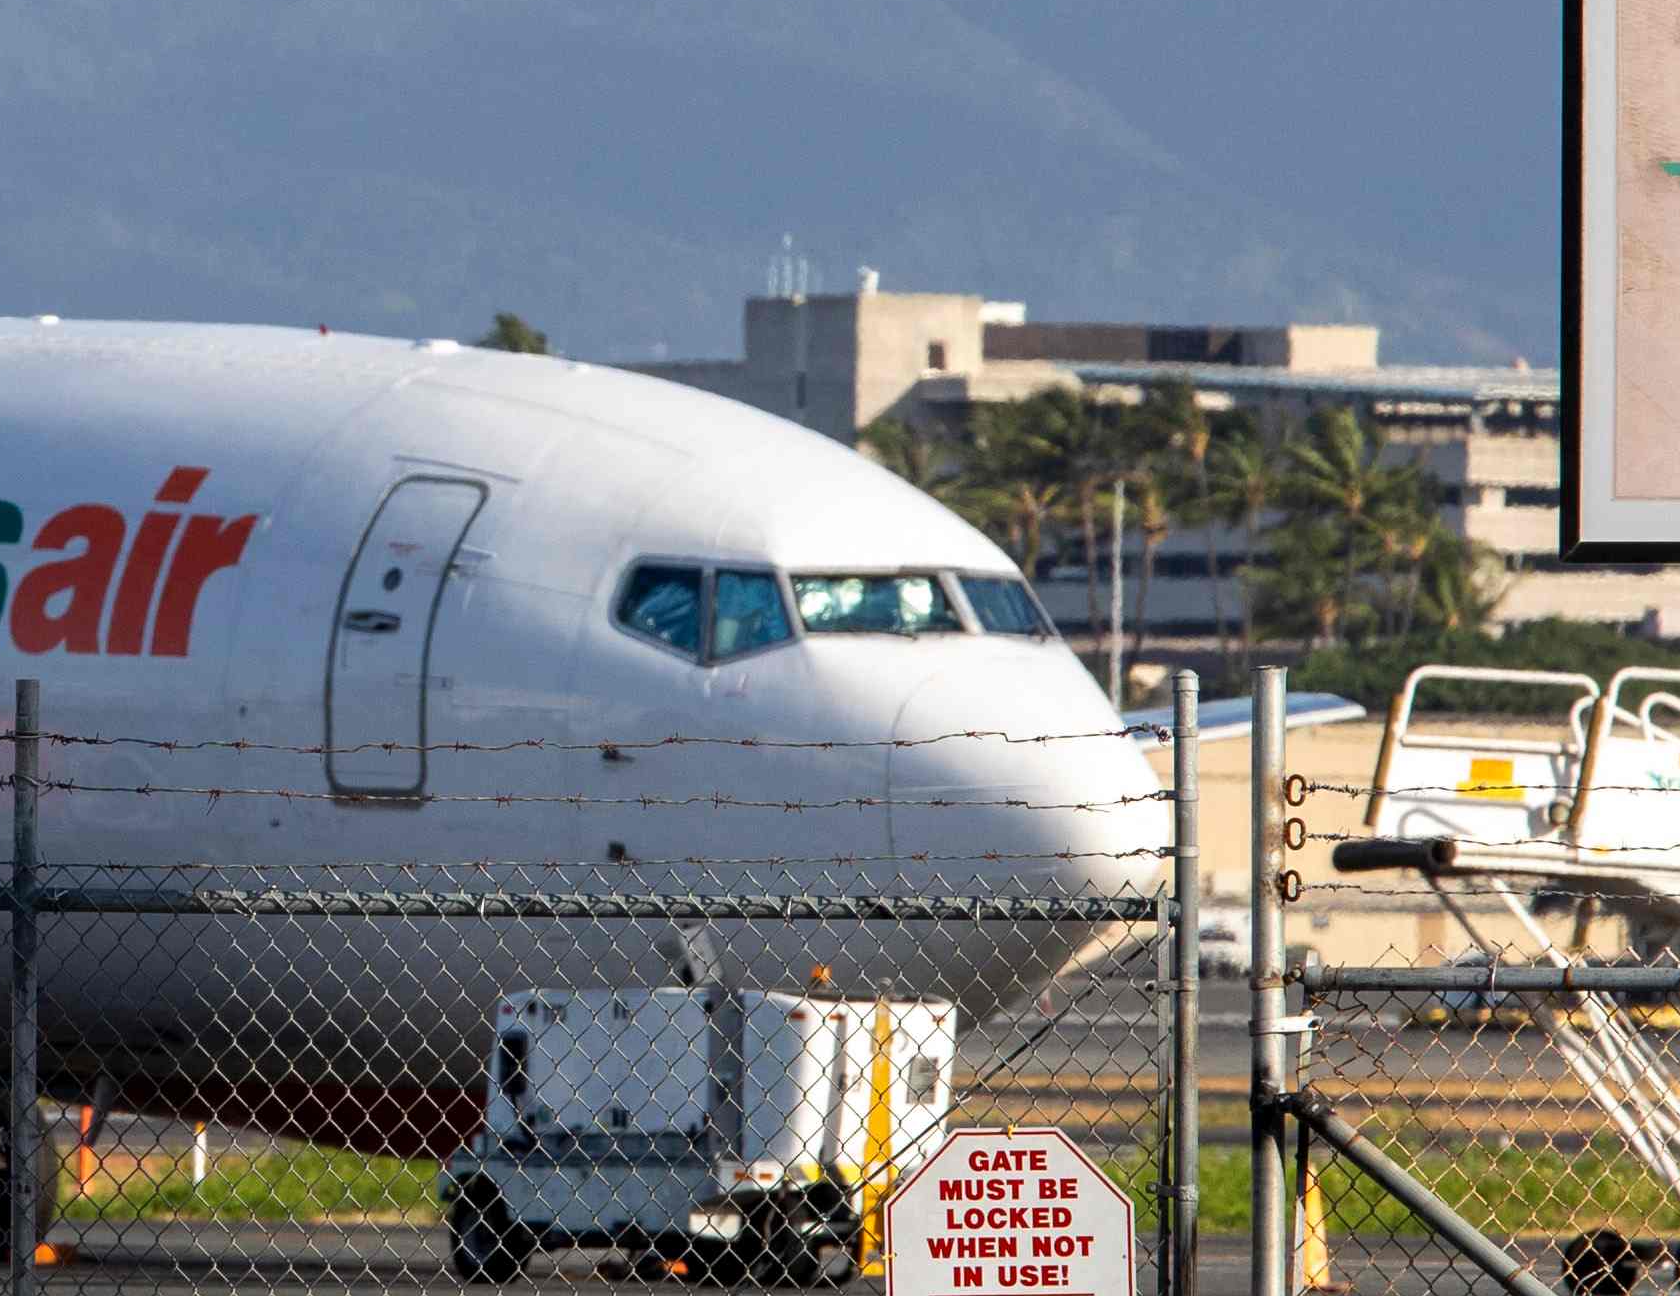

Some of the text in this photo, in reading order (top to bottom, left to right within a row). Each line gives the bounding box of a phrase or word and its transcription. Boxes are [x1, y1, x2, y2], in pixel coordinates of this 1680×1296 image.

[968, 1150, 1048, 1172] GATE
[939, 1178, 1078, 1201] MUST BE
[946, 1207, 1073, 1230] LOCKED
[927, 1235, 1094, 1259] WHEN NOT
[953, 1265, 1069, 1287] IN USE!
